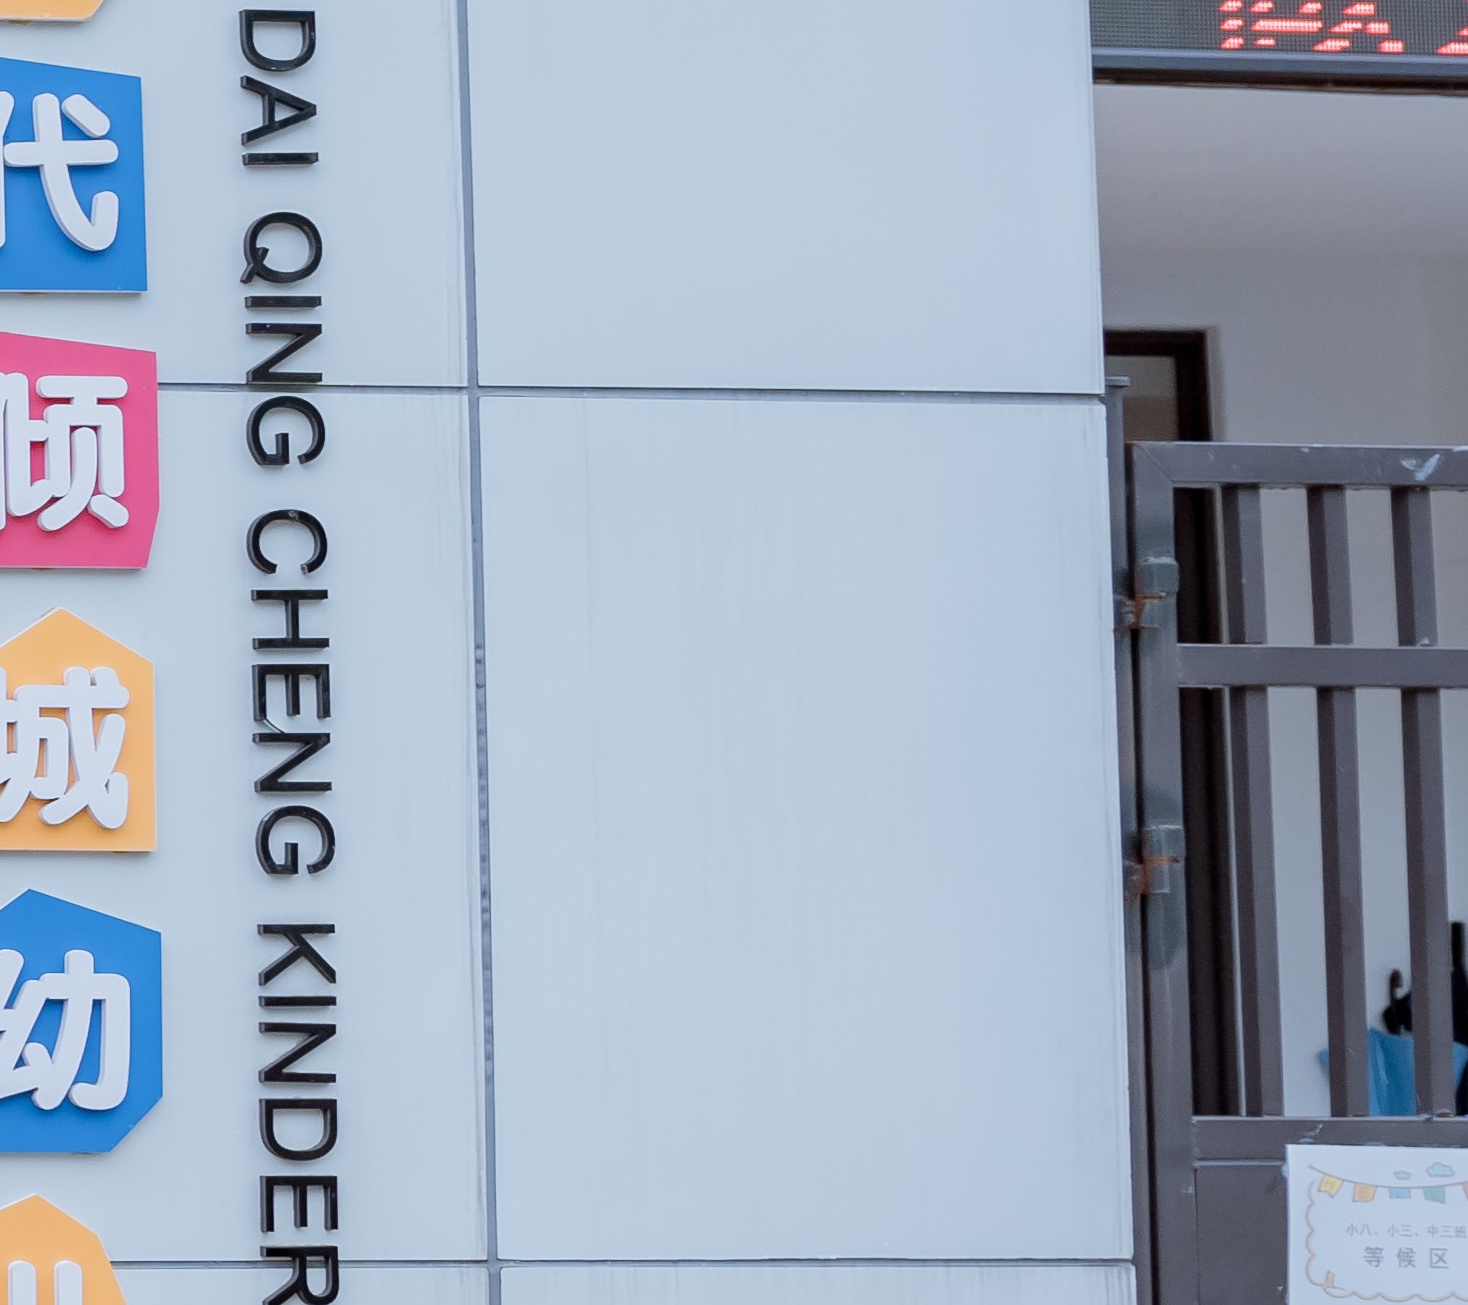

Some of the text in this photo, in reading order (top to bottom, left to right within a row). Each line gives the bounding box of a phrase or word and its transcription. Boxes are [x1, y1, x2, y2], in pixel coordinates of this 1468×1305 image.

[238, 9, 319, 167] DAI
[241, 211, 326, 467] QING
[246, 508, 338, 876] CHENG
[1363, 1246, 1450, 1270] 等候区
